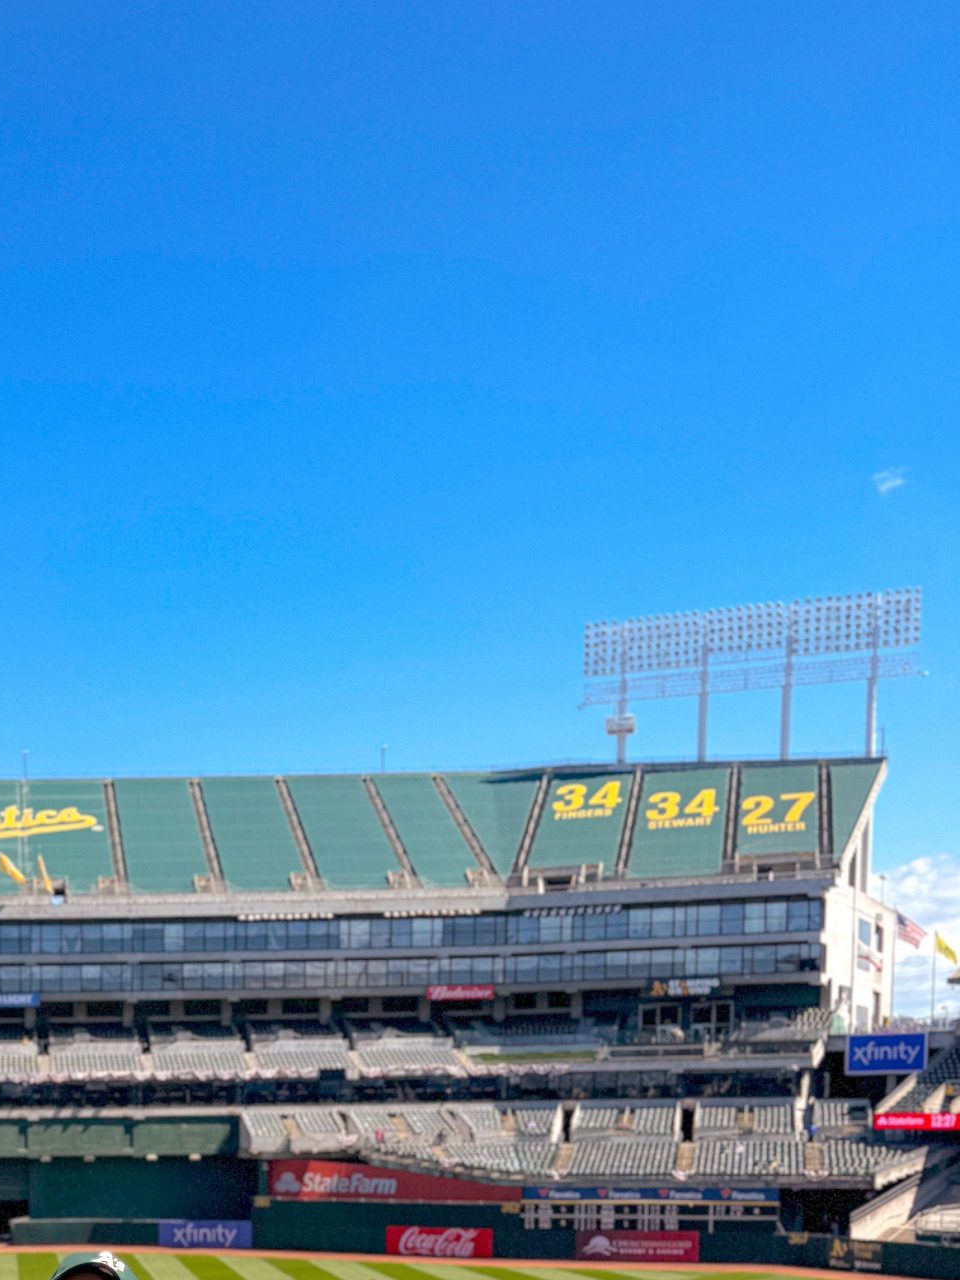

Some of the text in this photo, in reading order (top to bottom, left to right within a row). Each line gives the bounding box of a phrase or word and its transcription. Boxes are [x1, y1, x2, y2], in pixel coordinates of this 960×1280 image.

[552, 781, 622, 811] 34
[646, 789, 719, 819] 34
[554, 808, 613, 820] FINGERS
[741, 792, 815, 826] 27
[647, 817, 712, 829] STEWART
[747, 822, 806, 834] HUNTER
[853, 1040, 921, 1065] xfinity
[173, 1222, 237, 1246] xfinity
